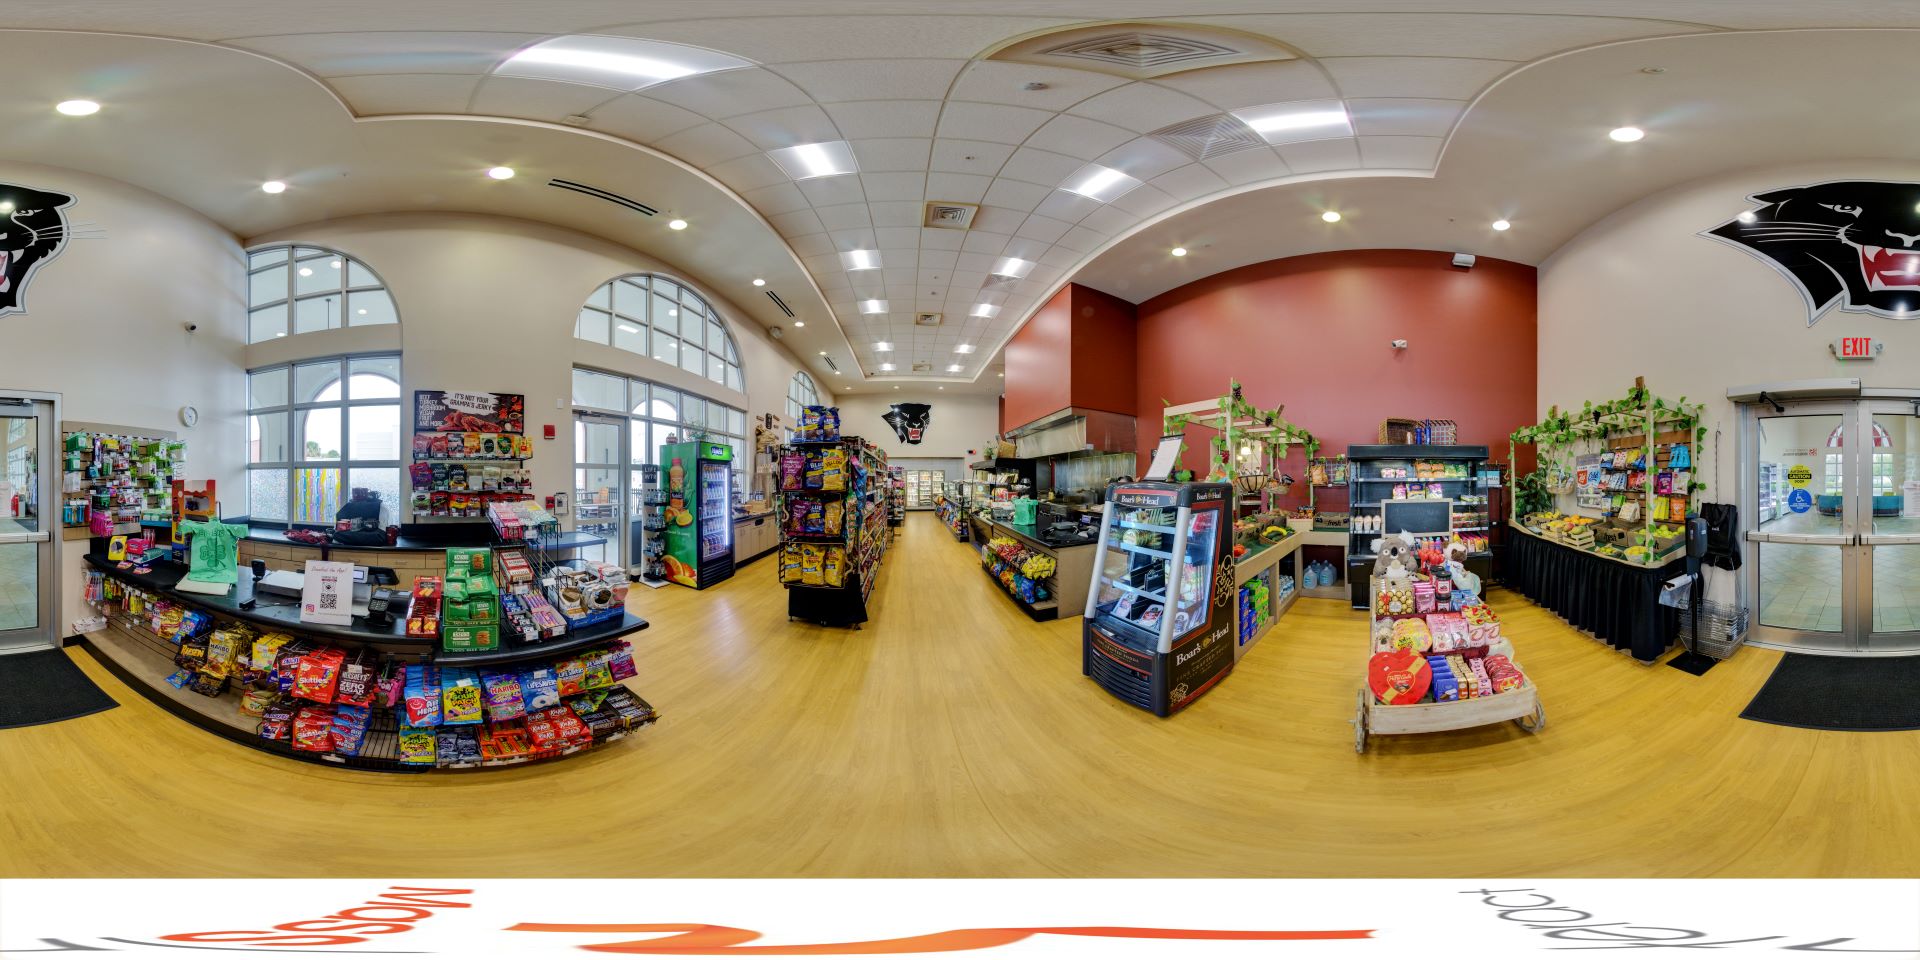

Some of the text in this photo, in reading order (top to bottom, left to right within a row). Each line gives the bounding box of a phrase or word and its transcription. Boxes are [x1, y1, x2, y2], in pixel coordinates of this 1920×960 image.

[1842, 337, 1872, 357] EXIT
[1143, 496, 1160, 505] Head
[210, 642, 231, 653] HARIBO
[1176, 622, 1230, 666] Boar's Head
[299, 676, 329, 685] Skittles
[340, 681, 365, 690] ZERO
[491, 684, 521, 695] HARIBO
